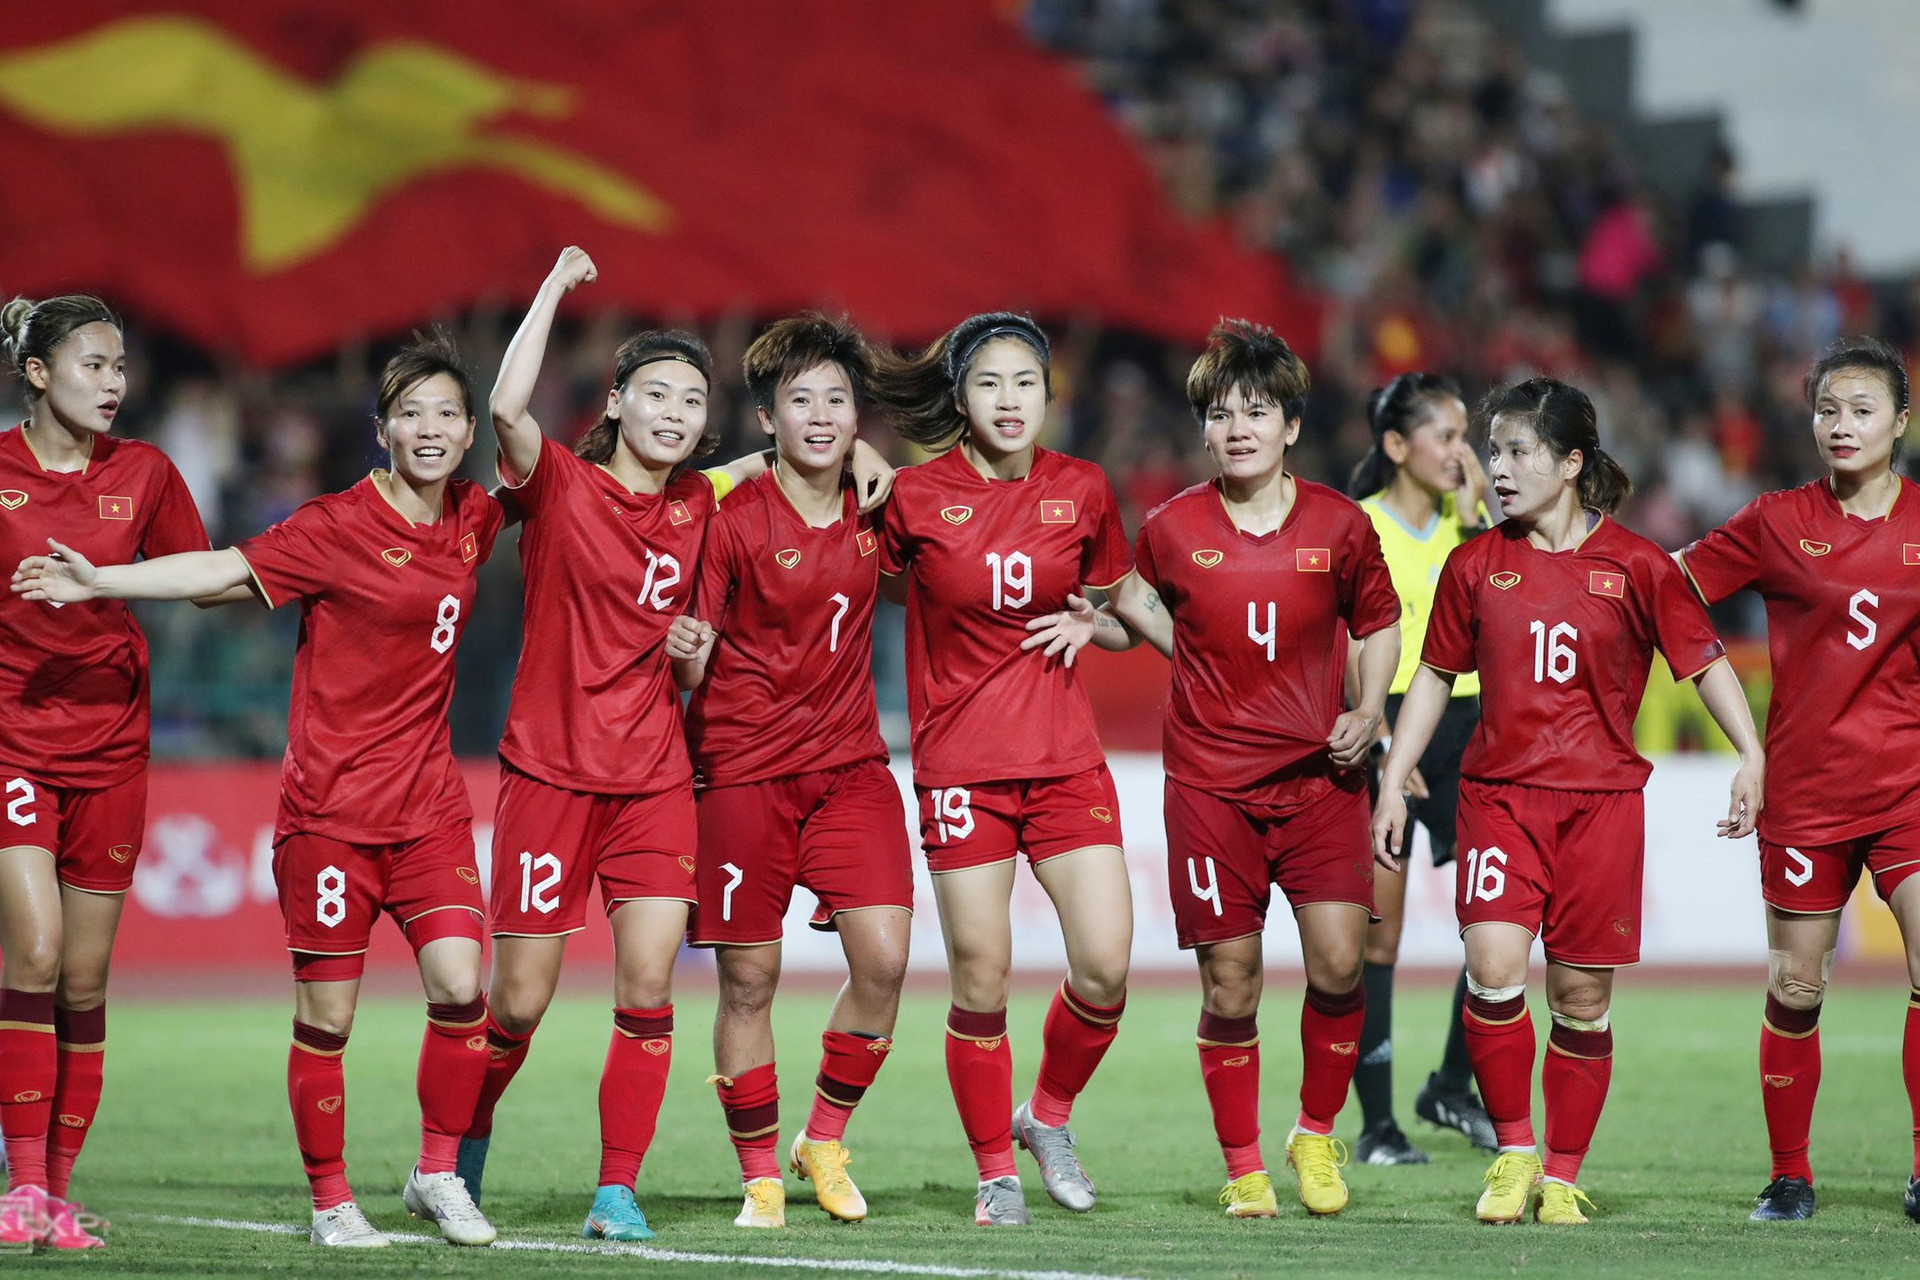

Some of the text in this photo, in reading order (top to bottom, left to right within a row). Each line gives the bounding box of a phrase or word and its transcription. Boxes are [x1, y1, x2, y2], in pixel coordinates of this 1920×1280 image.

[637, 547, 681, 611] 12
[985, 550, 1033, 611] 19
[430, 593, 461, 655] 8
[827, 592, 850, 653] 7
[1247, 601, 1276, 662] 4
[1530, 619, 1578, 684] 16
[5, 777, 37, 827] 2
[931, 786, 976, 844] 19
[316, 864, 346, 928] 8
[519, 851, 562, 915] 12
[719, 862, 744, 922] 7
[1187, 856, 1223, 917] 4
[1465, 846, 1508, 905] 16
